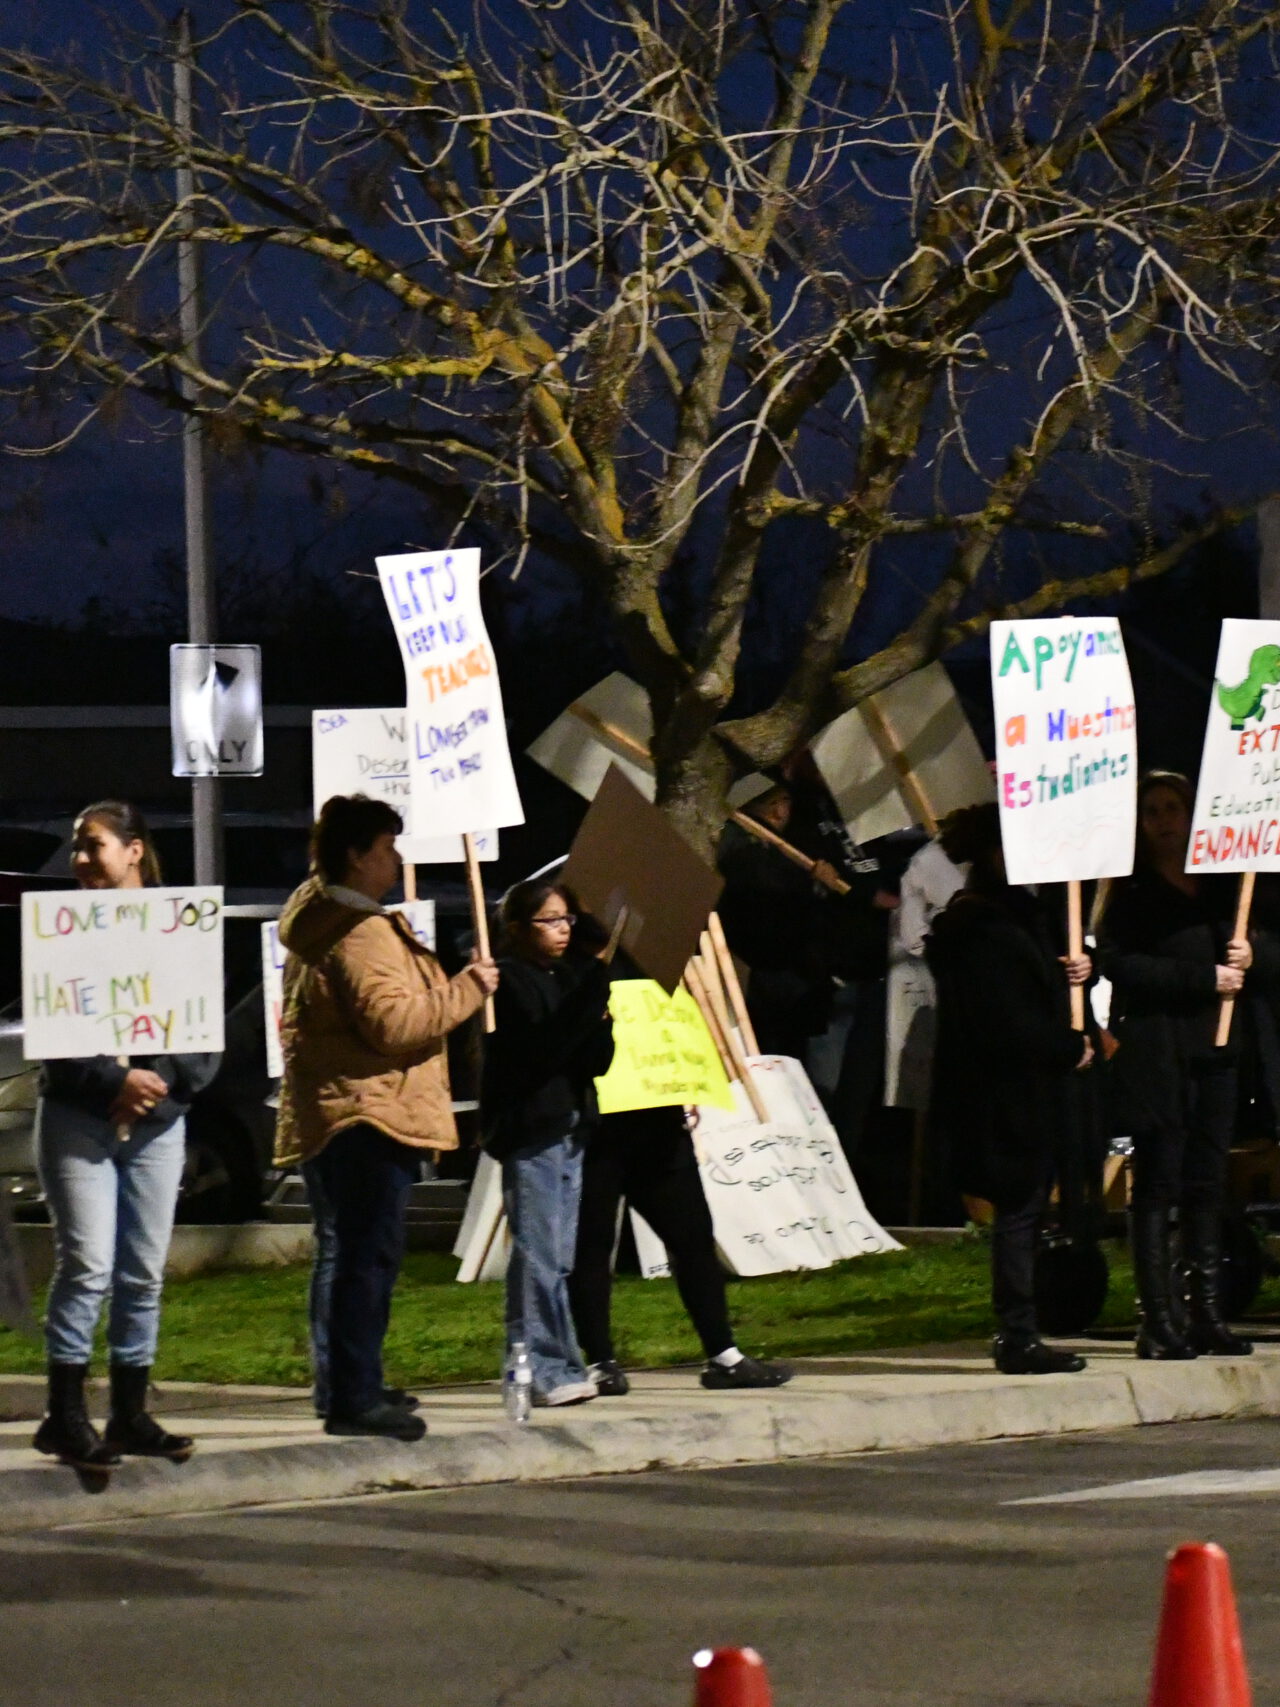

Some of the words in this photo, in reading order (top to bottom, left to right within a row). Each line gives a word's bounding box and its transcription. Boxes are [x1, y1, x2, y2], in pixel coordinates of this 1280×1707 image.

[357, 754, 410, 775] Deser
[33, 899, 107, 939] LOVE
[160, 896, 219, 934] JOB
[33, 973, 97, 1017] HATE
[110, 971, 150, 1010] MY
